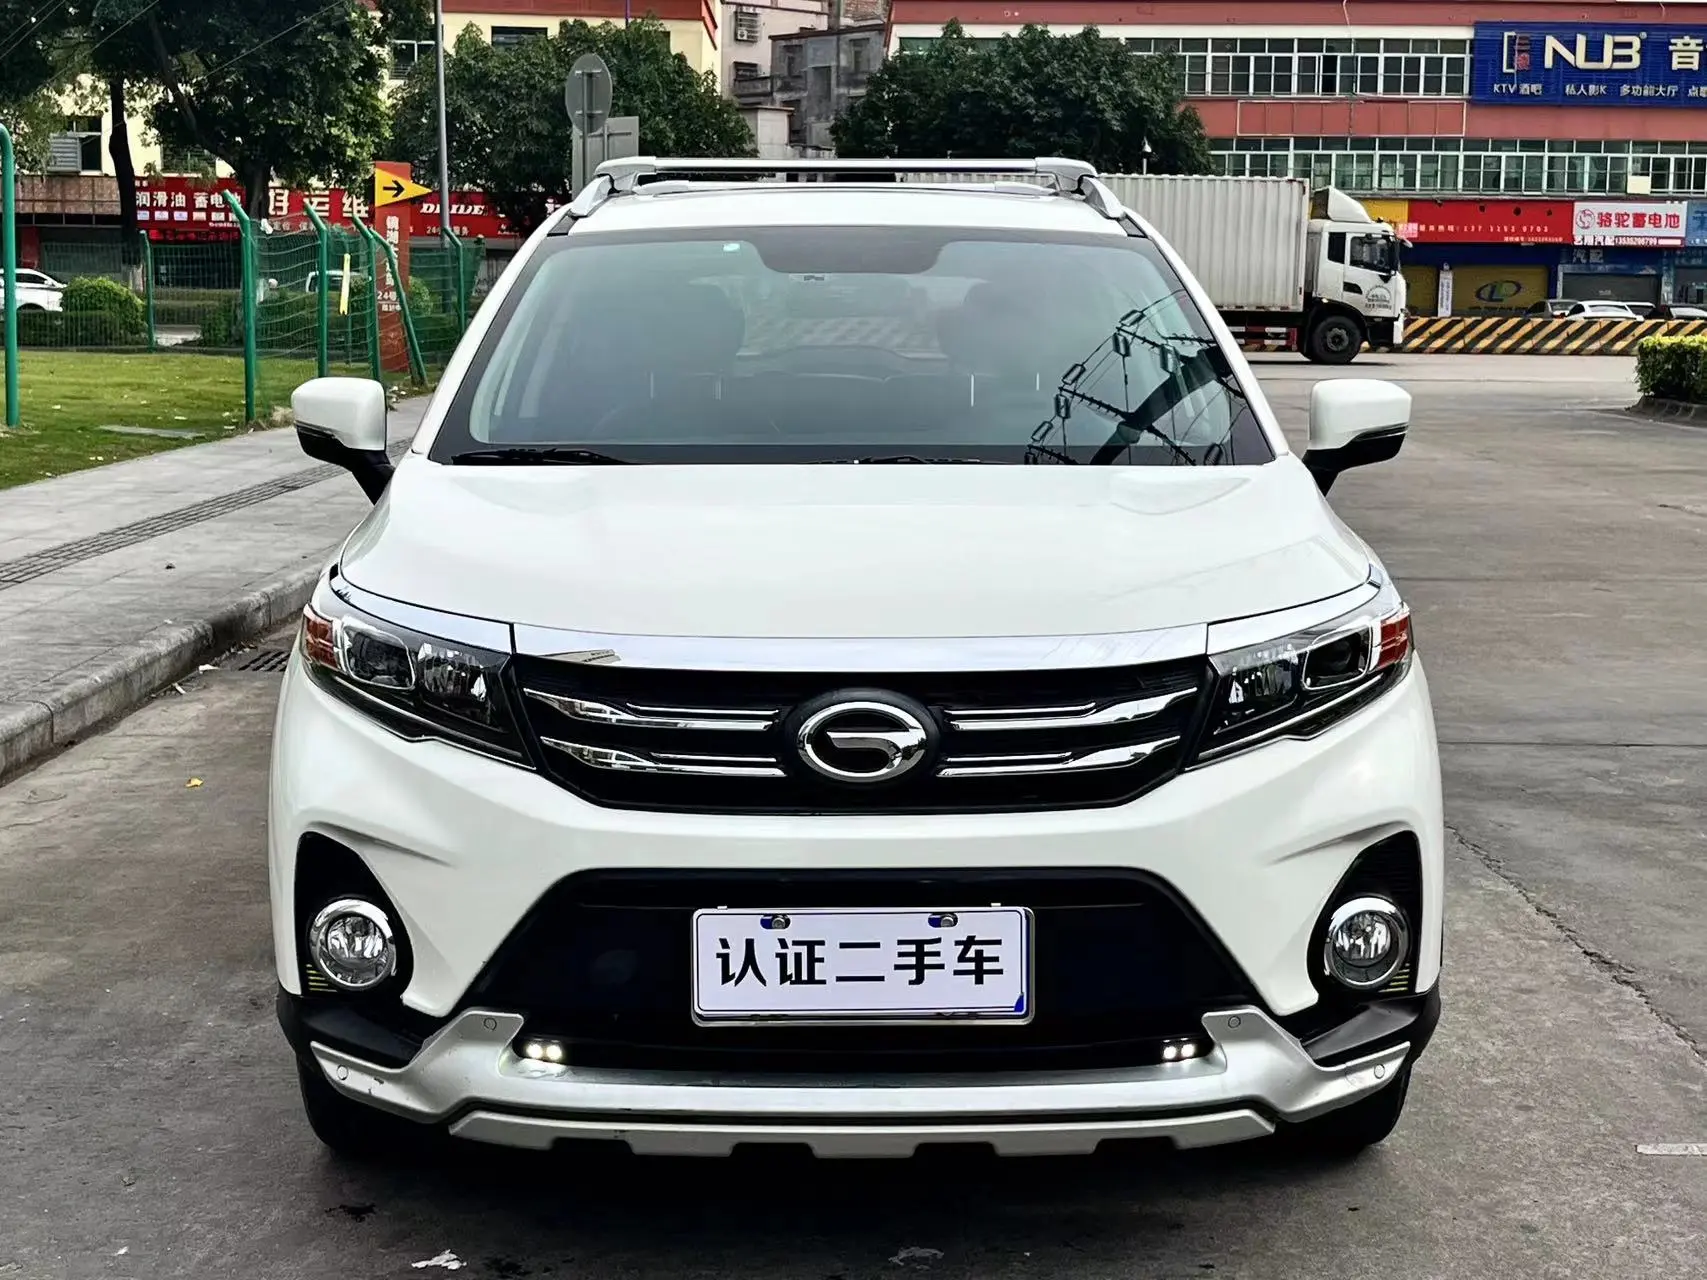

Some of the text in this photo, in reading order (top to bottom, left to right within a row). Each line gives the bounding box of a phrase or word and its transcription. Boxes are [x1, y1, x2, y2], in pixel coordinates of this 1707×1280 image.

[1668, 35, 1707, 71] 音
[1493, 84, 1517, 94] KTV
[1519, 83, 1543, 95] 酒吧
[1620, 84, 1678, 97] 多功能大厅
[1597, 211, 1680, 229] 骆驼蓄电池
[716, 935, 1003, 987] 认证二手车
